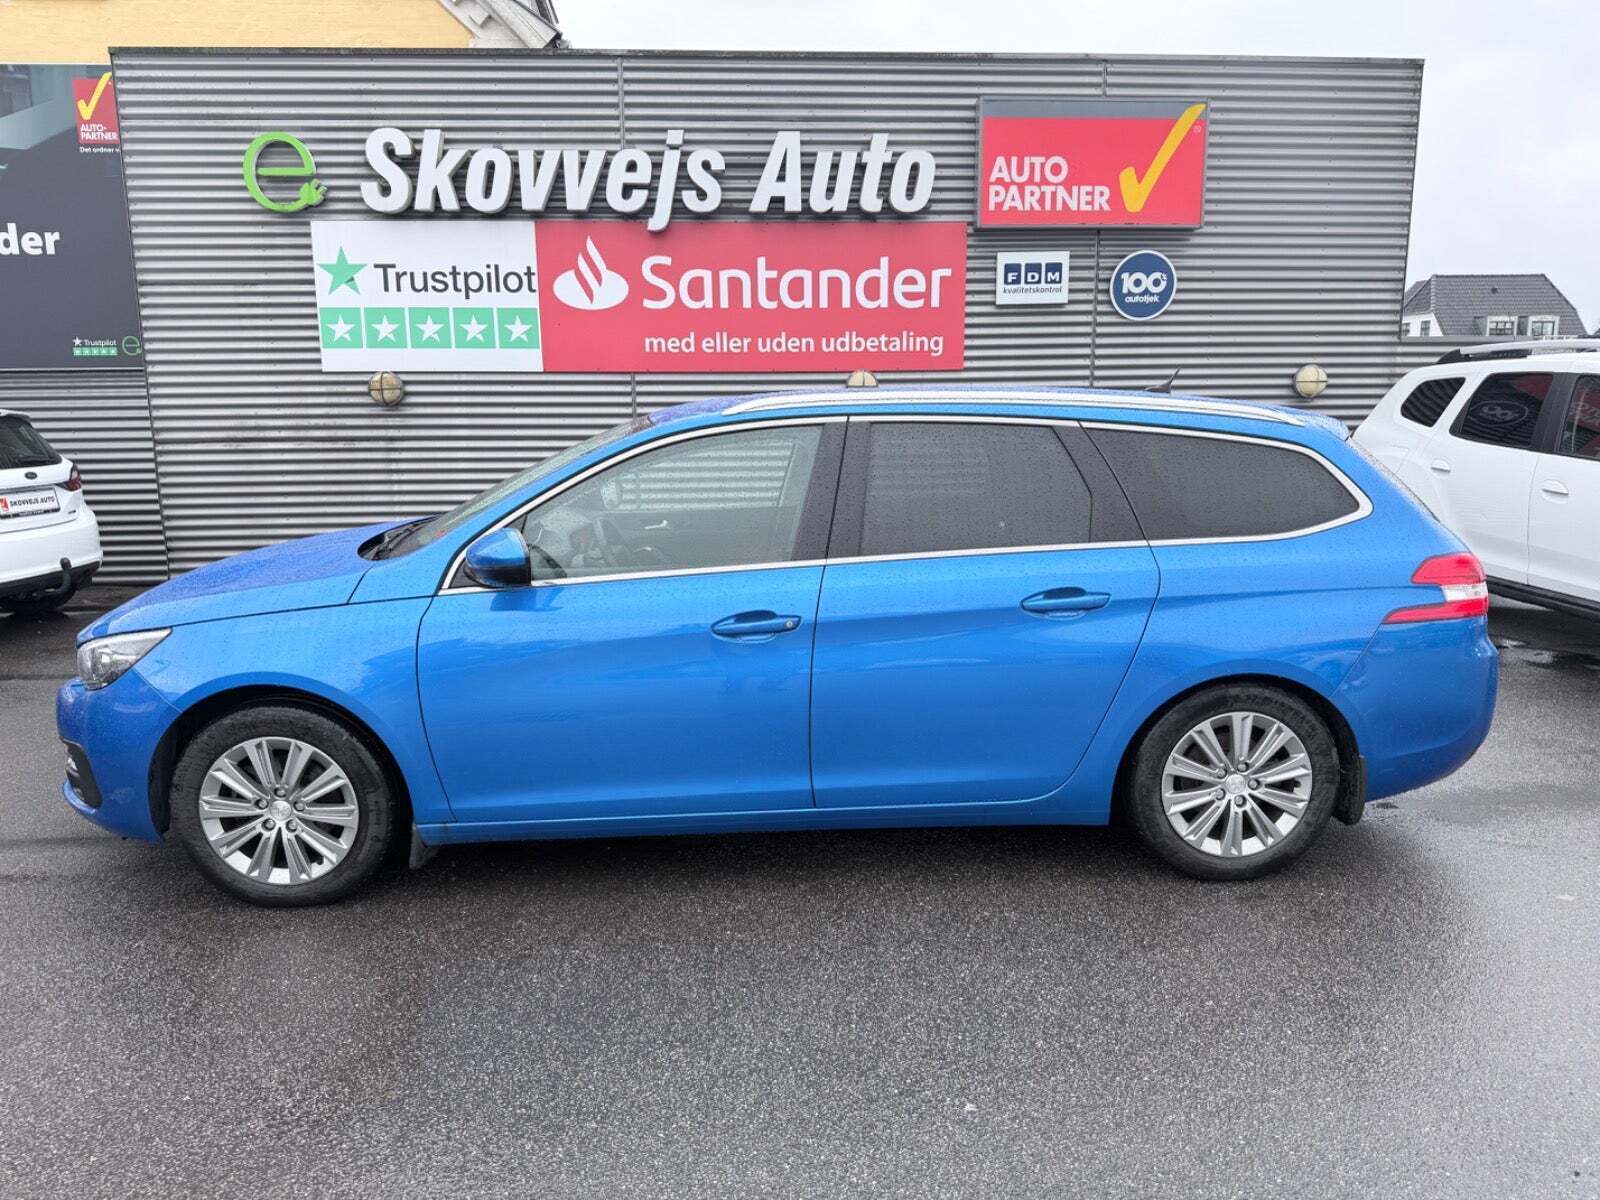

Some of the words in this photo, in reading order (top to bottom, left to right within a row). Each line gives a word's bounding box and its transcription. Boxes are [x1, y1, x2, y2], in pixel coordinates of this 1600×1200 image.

[80, 131, 118, 140] PARTNER
[360, 127, 725, 231] Skovvejs
[749, 130, 936, 213] Auto
[989, 155, 1069, 184] AUTO
[988, 184, 1111, 212] PARTNER
[373, 264, 537, 299] Trustpilot
[641, 256, 952, 310] Santander
[1006, 269, 1061, 284] FDM
[1003, 286, 1062, 294] kvalitetskontrol
[1125, 294, 1160, 304] autotjek
[84, 338, 117, 348] Trustpilot
[644, 332, 695, 353] med
[701, 332, 752, 353] eller
[757, 332, 815, 353] uden
[821, 331, 944, 357] udbetaling
[40, 496, 55, 504] AUTO
